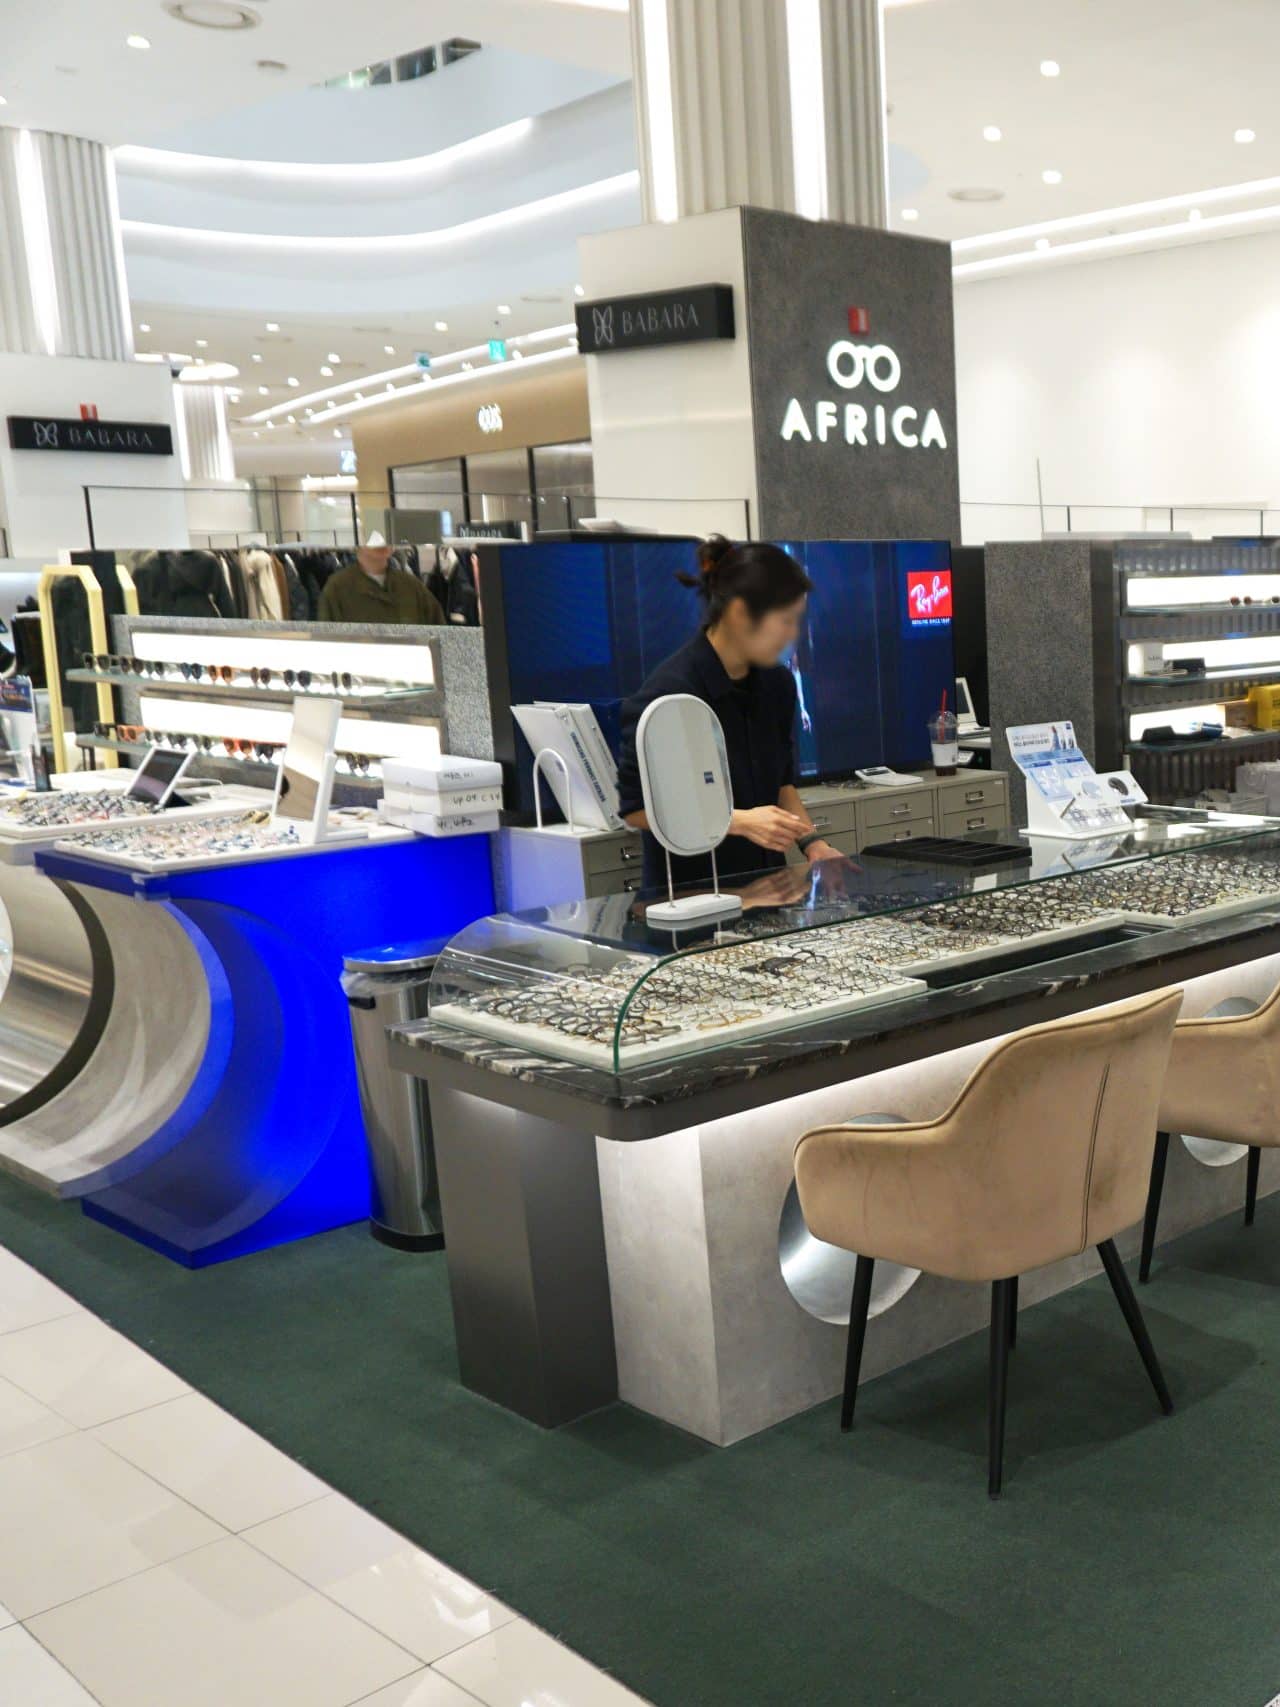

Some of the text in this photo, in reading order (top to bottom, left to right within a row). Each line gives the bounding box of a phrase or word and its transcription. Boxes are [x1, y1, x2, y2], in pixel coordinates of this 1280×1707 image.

[622, 303, 699, 335] BABARA
[68, 427, 153, 448] BABARA
[780, 398, 947, 449] AFRICA
